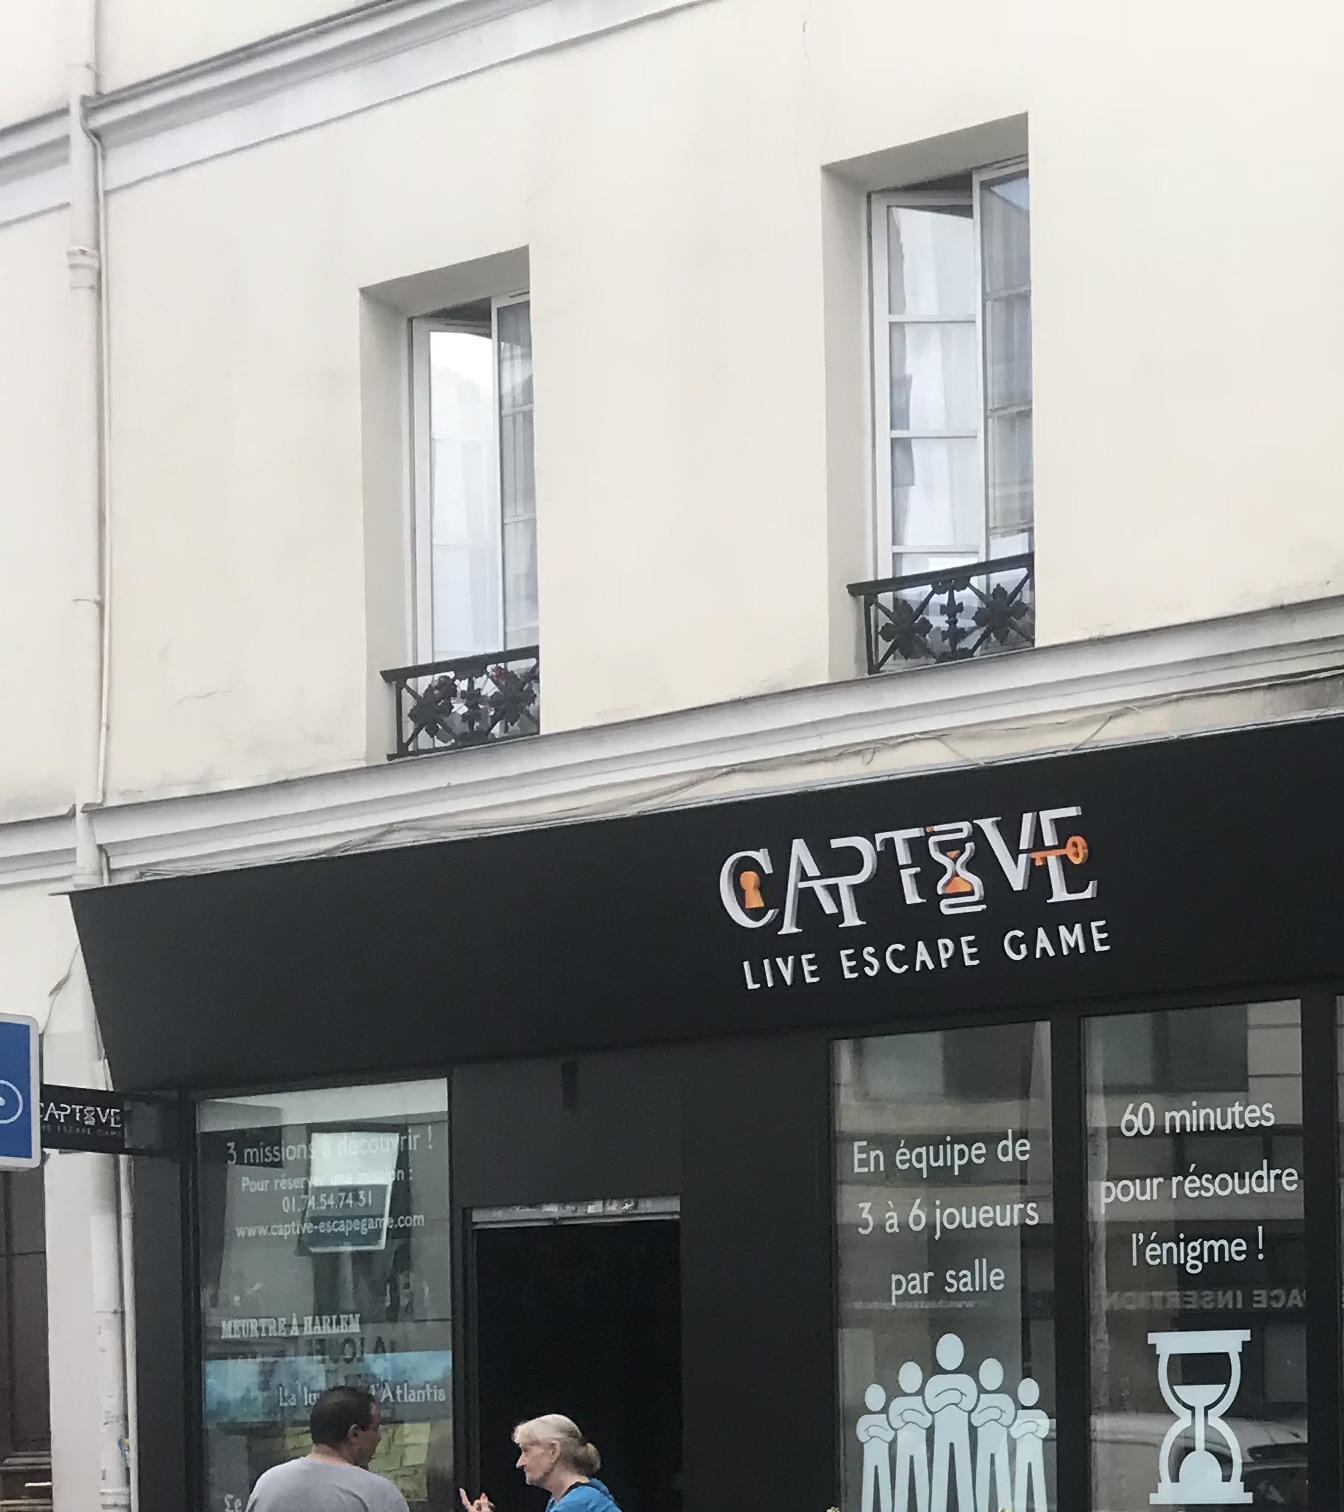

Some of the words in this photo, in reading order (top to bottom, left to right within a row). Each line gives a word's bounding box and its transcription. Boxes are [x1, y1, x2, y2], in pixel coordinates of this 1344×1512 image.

[742, 953, 820, 990] LIVE
[841, 935, 980, 979] ESCAPE
[1003, 920, 1111, 962] GAME
[1120, 1103, 1154, 1137] 60
[1164, 1101, 1275, 1134] minutes
[226, 1142, 237, 1165] 3
[244, 1142, 314, 1164] missions
[853, 1141, 884, 1174] En
[896, 1136, 986, 1178] équipe
[998, 1129, 1031, 1163] de
[242, 1176, 269, 1192] Pour
[1101, 1172, 1165, 1214] pour
[1171, 1160, 1299, 1199] résoudre
[858, 1200, 873, 1234] 3
[886, 1202, 900, 1234] à
[908, 1197, 926, 1231] 6
[933, 1200, 1039, 1239] joueurs
[1132, 1232, 1248, 1274] l'énigme
[1256, 1226, 1264, 1259] !
[891, 1268, 933, 1305] par
[945, 1258, 1005, 1293] salle
[221, 1317, 287, 1339] MEURTRE
[303, 1313, 361, 1335] HARLEM
